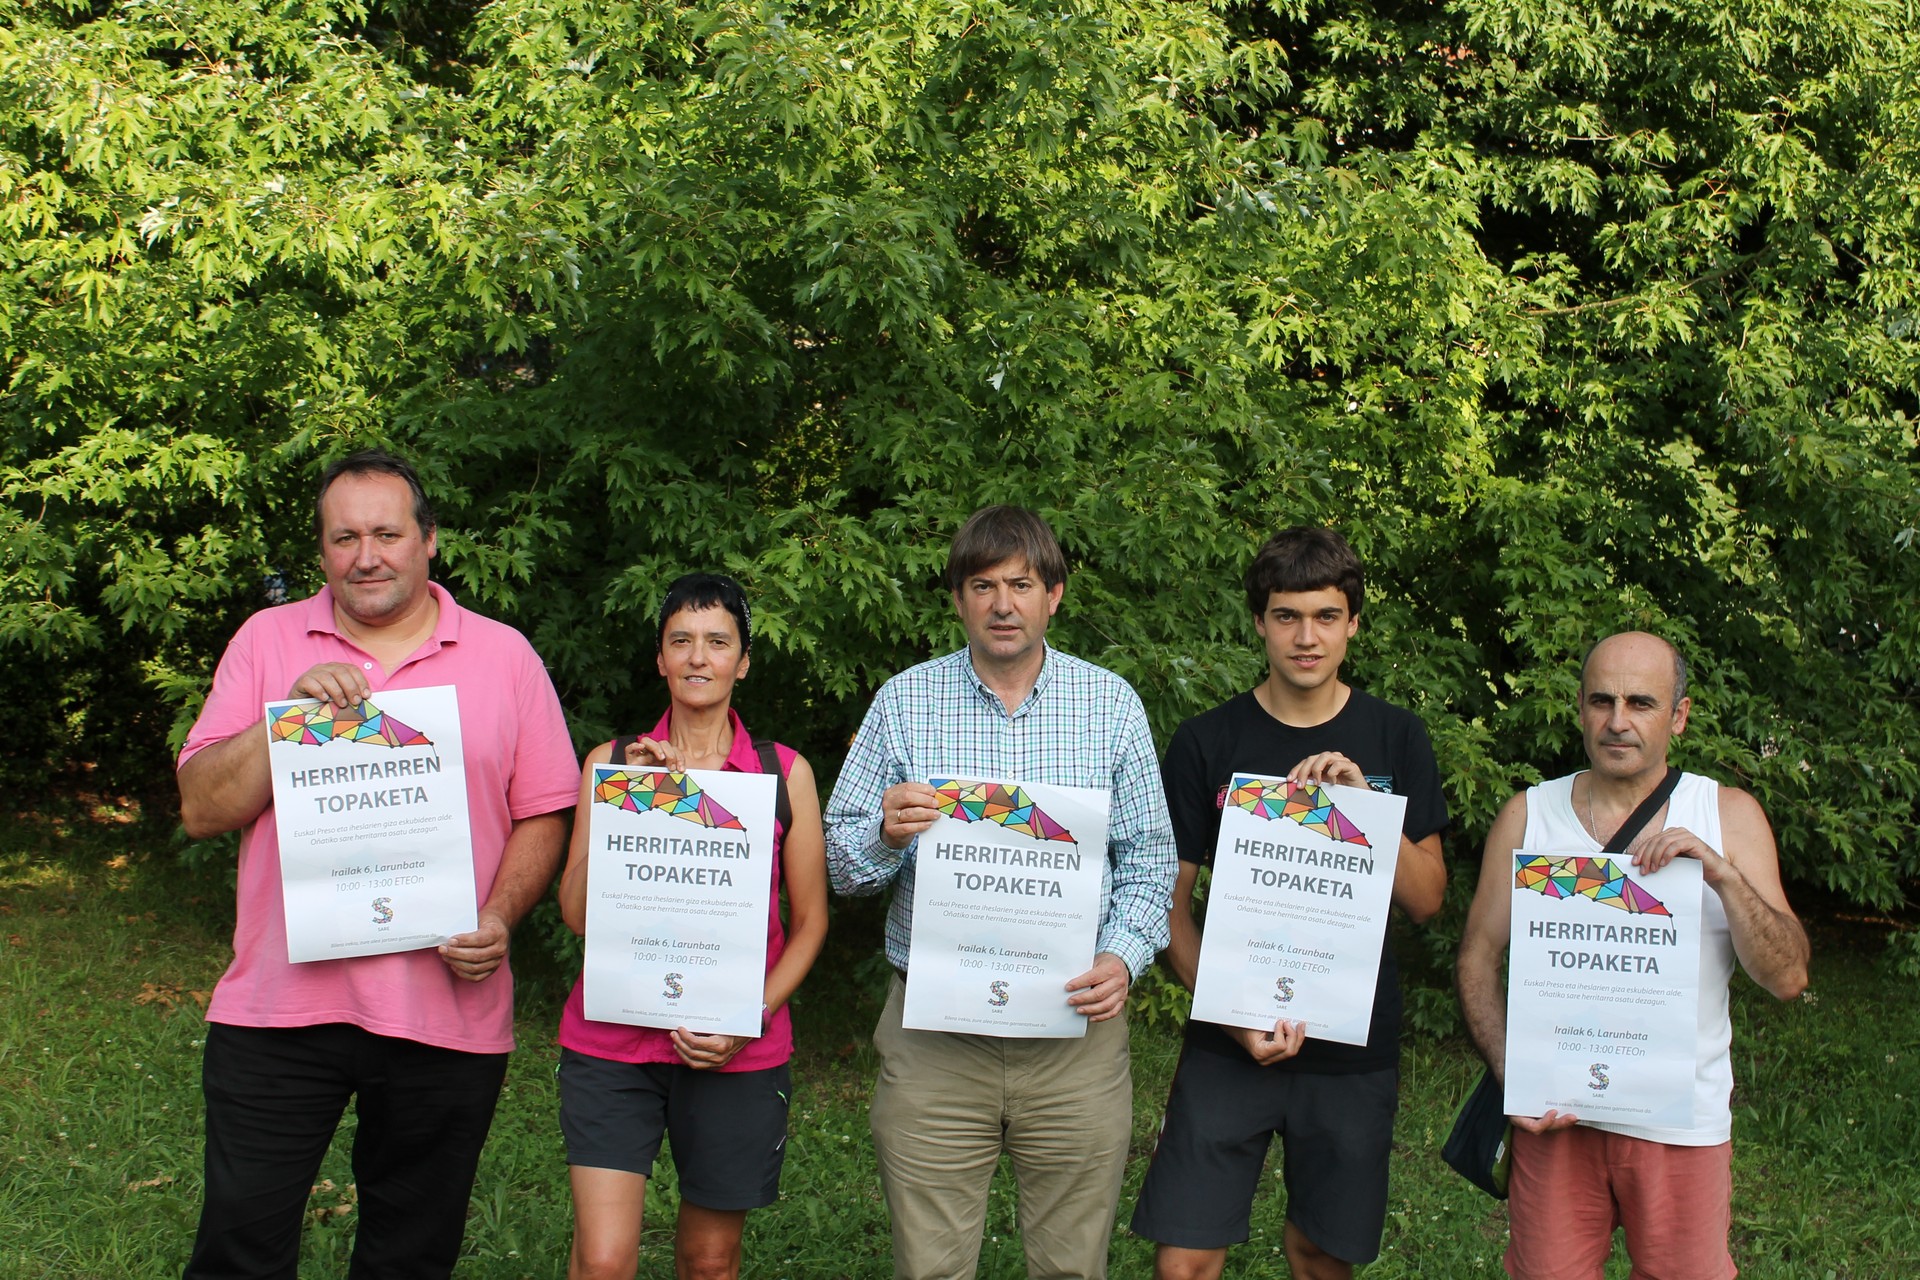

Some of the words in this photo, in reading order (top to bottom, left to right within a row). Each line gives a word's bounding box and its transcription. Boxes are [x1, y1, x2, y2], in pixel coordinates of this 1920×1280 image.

[291, 756, 441, 788] HERRITARREN
[314, 786, 429, 814] TOPAKETA
[293, 828, 316, 838] Euskal
[316, 827, 336, 835] Preso
[382, 820, 397, 829] giza
[387, 829, 407, 837] osatu
[607, 834, 750, 860] HERRITARREN
[935, 842, 1081, 872] HERRITARREN
[1234, 837, 1374, 875] HERRITARREN
[331, 866, 362, 878] Irailak
[364, 865, 373, 875] 6,
[375, 860, 425, 873] Larunbata
[625, 863, 733, 887] TOPAKETA
[335, 881, 361, 893] 10:00
[368, 877, 393, 889] 13:00
[394, 873, 425, 886] ETEOn
[953, 872, 1062, 898] TOPAKETA
[1250, 867, 1353, 900] TOPAKETA
[601, 891, 623, 900] Euskal
[623, 893, 641, 901] Preso
[685, 897, 700, 906] giza
[928, 899, 951, 908] Euskal
[950, 901, 969, 910] Preso
[1013, 907, 1029, 916] giza
[1223, 892, 1245, 902] Euskal
[1244, 895, 1263, 905] Preso
[1305, 906, 1320, 914] giza
[1262, 909, 1277, 917] sare
[1308, 917, 1327, 925] osatu
[1529, 920, 1677, 946] HERRITARREN
[630, 936, 660, 946] Irailak
[661, 938, 670, 948] 6,
[672, 939, 721, 951] Larunbata
[957, 944, 987, 955] Irailak
[988, 947, 997, 957] 6,
[999, 948, 1048, 960] Larunbata
[1247, 938, 1277, 950] Irailak
[1277, 943, 1285, 953] 6,
[1287, 944, 1335, 960] Larunbata
[633, 951, 657, 962] 10:00
[664, 953, 688, 964] 13:00
[688, 955, 719, 966] ETEOn
[960, 959, 984, 970] 10:00
[991, 962, 1015, 973] 13:00
[1015, 964, 1046, 975] ETEOn
[1248, 953, 1273, 965] 10:00
[1278, 958, 1302, 970] 13:00
[1301, 961, 1332, 975] ETEOn
[1548, 950, 1660, 975] TOPAKETA
[1523, 979, 1546, 987] Euskal
[1546, 980, 1565, 989] Preso
[1610, 985, 1626, 994] giza
[1554, 1025, 1585, 1036] Irailak
[1586, 1027, 1595, 1038] 6,
[1597, 1028, 1648, 1041] Larunbata
[1557, 1040, 1582, 1052] 10:00
[1589, 1043, 1614, 1054] 13:00
[1614, 1045, 1646, 1057] ETEOn
